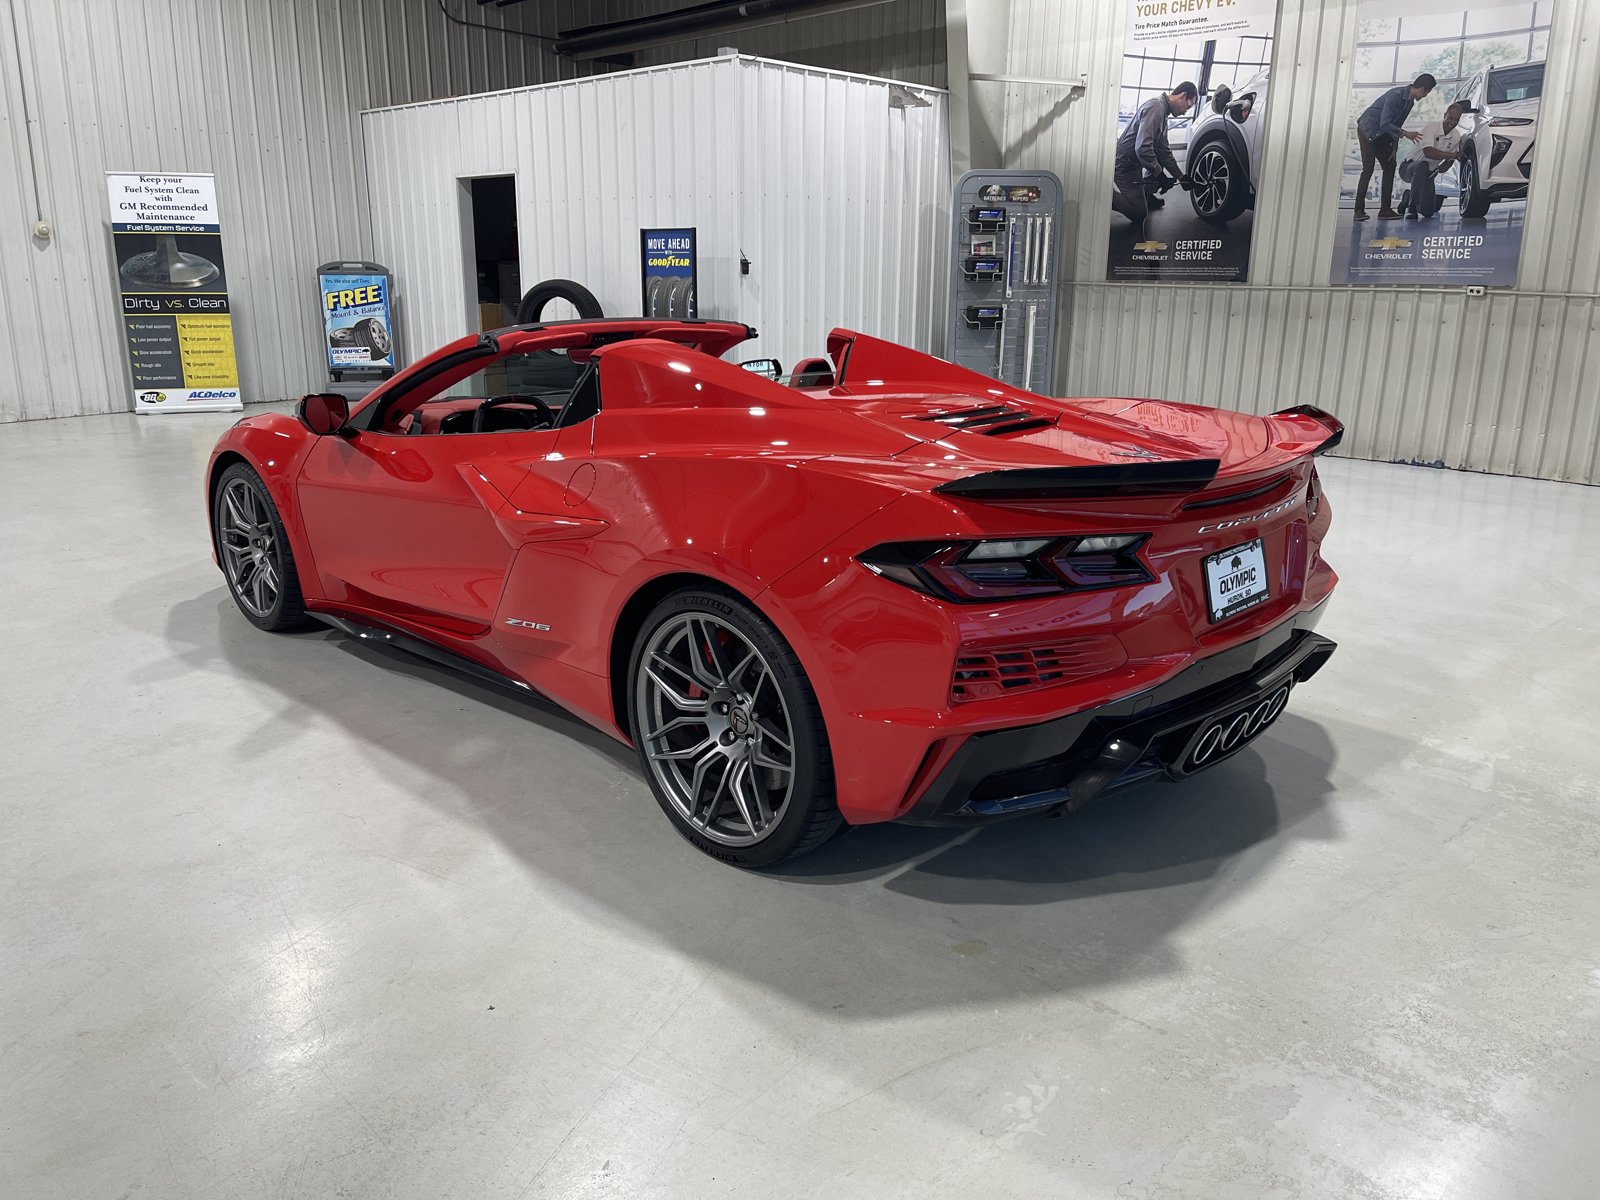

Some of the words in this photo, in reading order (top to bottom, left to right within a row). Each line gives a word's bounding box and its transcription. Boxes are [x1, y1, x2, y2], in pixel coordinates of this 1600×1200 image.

[1136, 4, 1167, 17] YOUR
[1172, 0, 1212, 12] CHEVY
[139, 176, 161, 185] Keep
[140, 203, 208, 212] Recommended
[136, 213, 195, 221] Maintenance
[648, 239, 665, 249] MOVE
[668, 238, 690, 249] AHEAD
[1175, 240, 1222, 250] CERTIFIED
[1423, 235, 1483, 246] CERTIFIED
[1174, 251, 1212, 260] SERVICE
[1421, 249, 1471, 259] SERVICE
[326, 285, 381, 310] FREE
[124, 298, 160, 311] Dirty
[165, 300, 185, 308] vs.
[188, 298, 226, 308] Clean
[361, 306, 385, 314] Balance
[1198, 495, 1298, 533] CORVETTE
[1220, 567, 1256, 595] OLYMPIC
[1228, 594, 1244, 605] HURON,
[686, 597, 731, 614] MICHELIN
[1036, 610, 1084, 626] FOR
[505, 618, 551, 630] Z06
